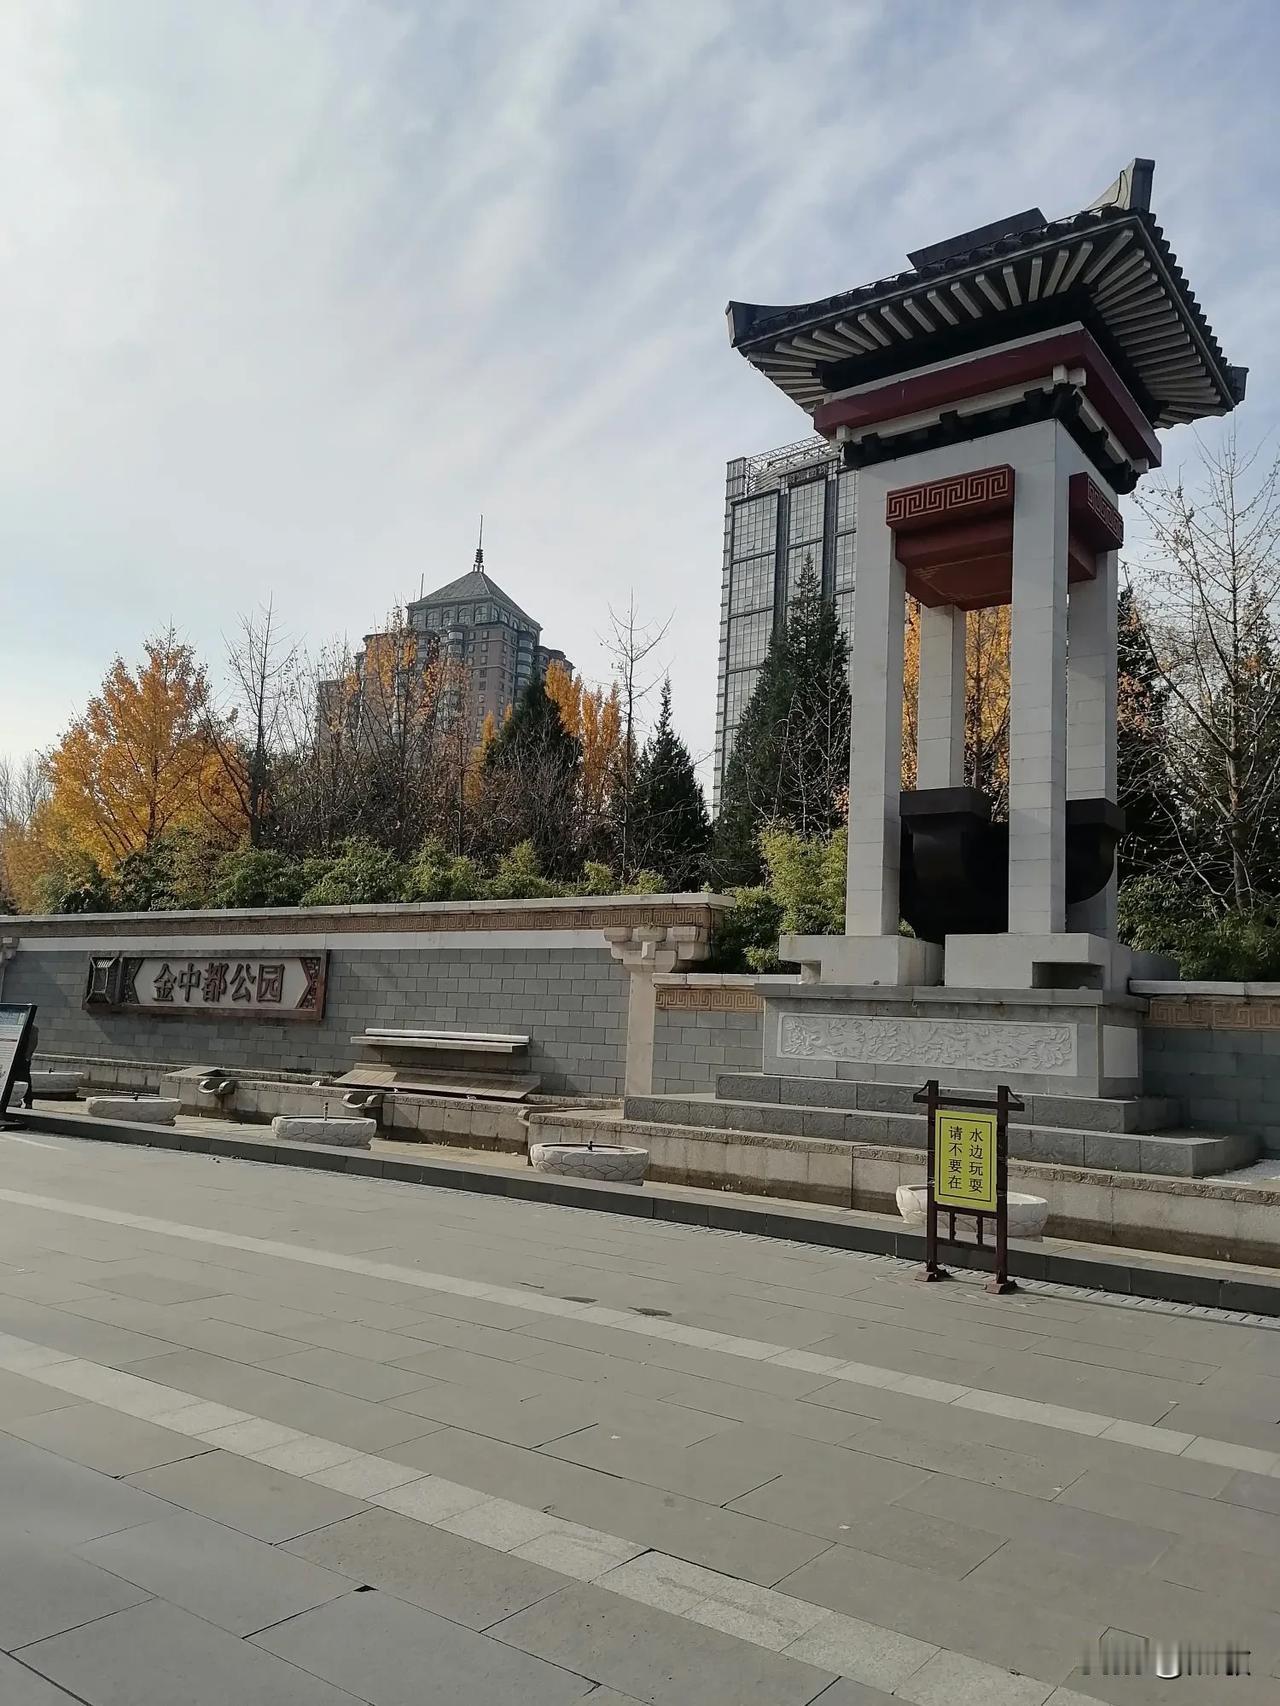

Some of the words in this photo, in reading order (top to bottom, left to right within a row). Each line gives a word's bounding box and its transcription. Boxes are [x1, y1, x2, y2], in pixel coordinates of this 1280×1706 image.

[152, 962, 285, 1003] 金中都公园
[948, 1125, 963, 1190] 请不要在
[968, 1127, 984, 1194] 水边玩耍
